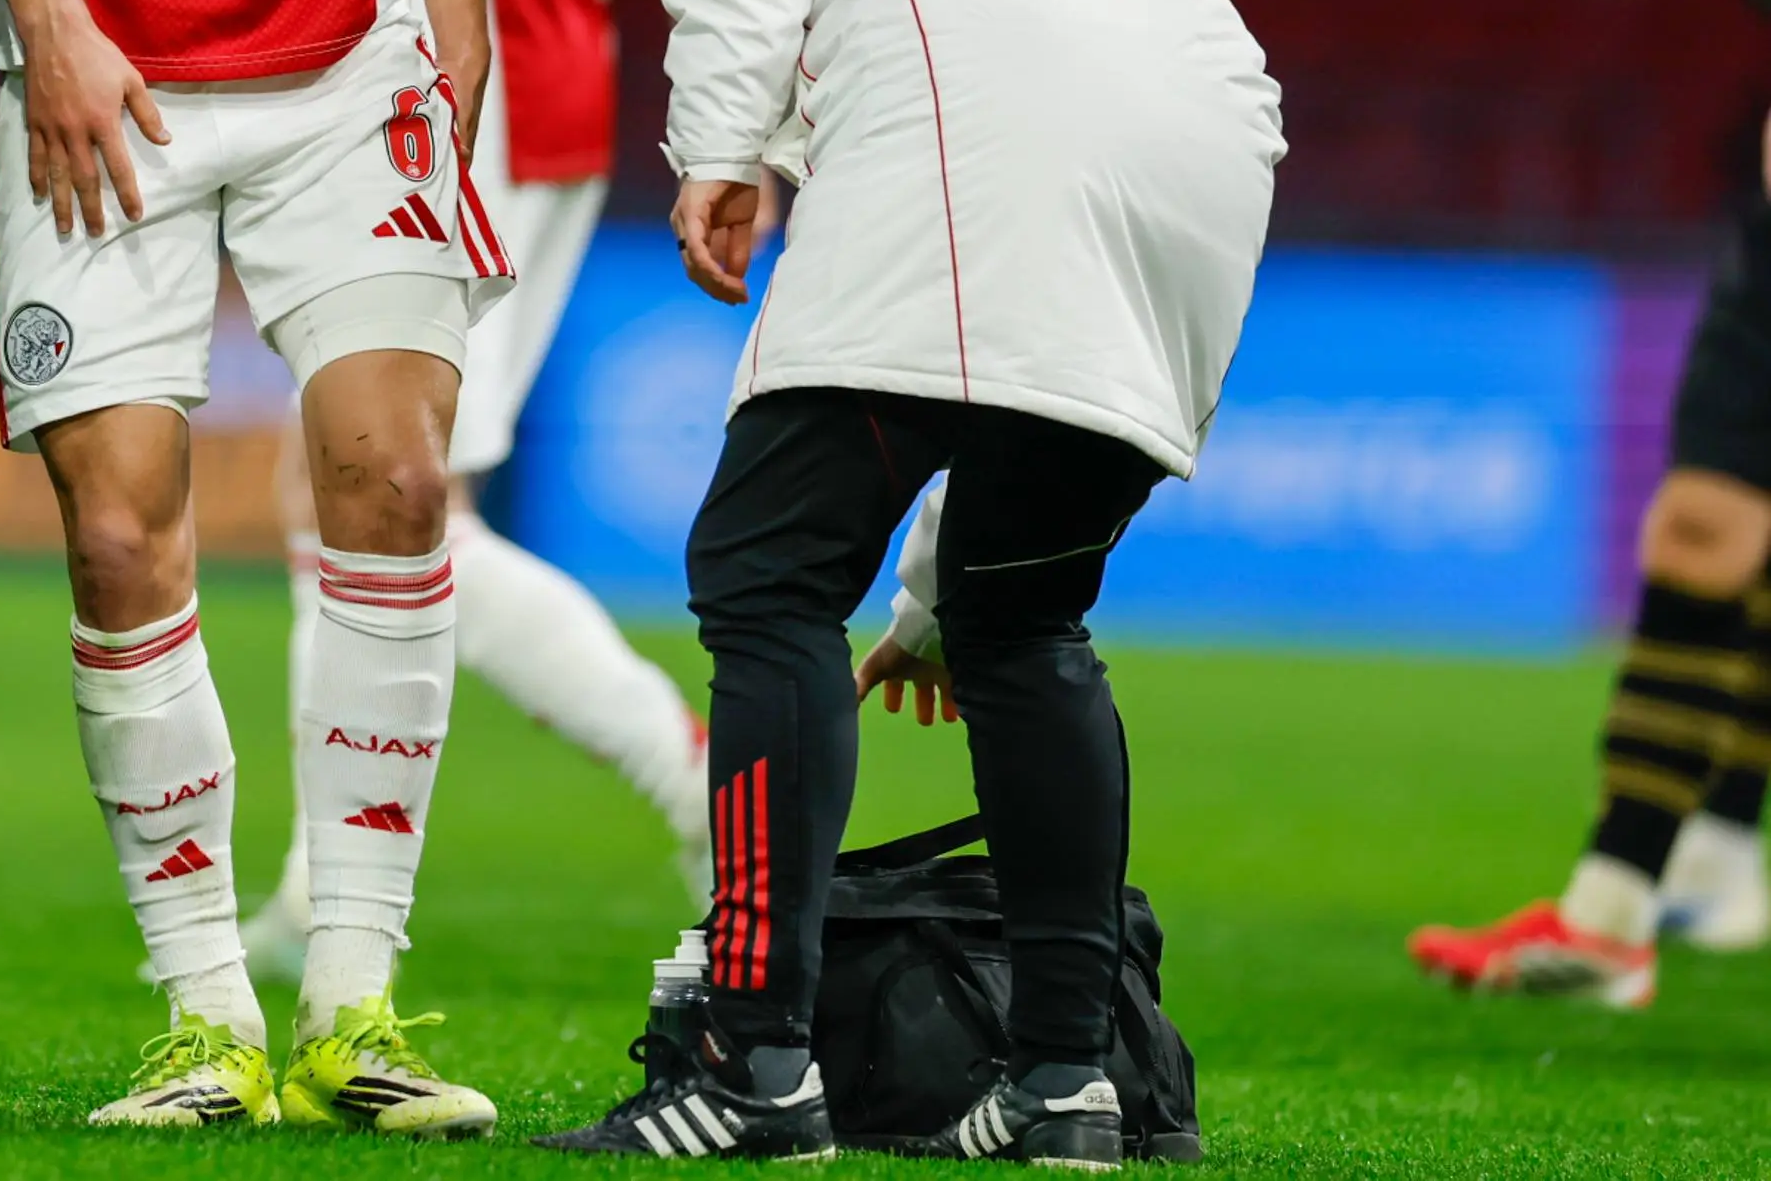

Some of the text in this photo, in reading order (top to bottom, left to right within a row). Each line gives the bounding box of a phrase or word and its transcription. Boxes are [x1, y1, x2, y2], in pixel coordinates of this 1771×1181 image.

[383, 84, 436, 182] 6
[325, 727, 440, 759] AJAX
[117, 771, 220, 816] AJAX
